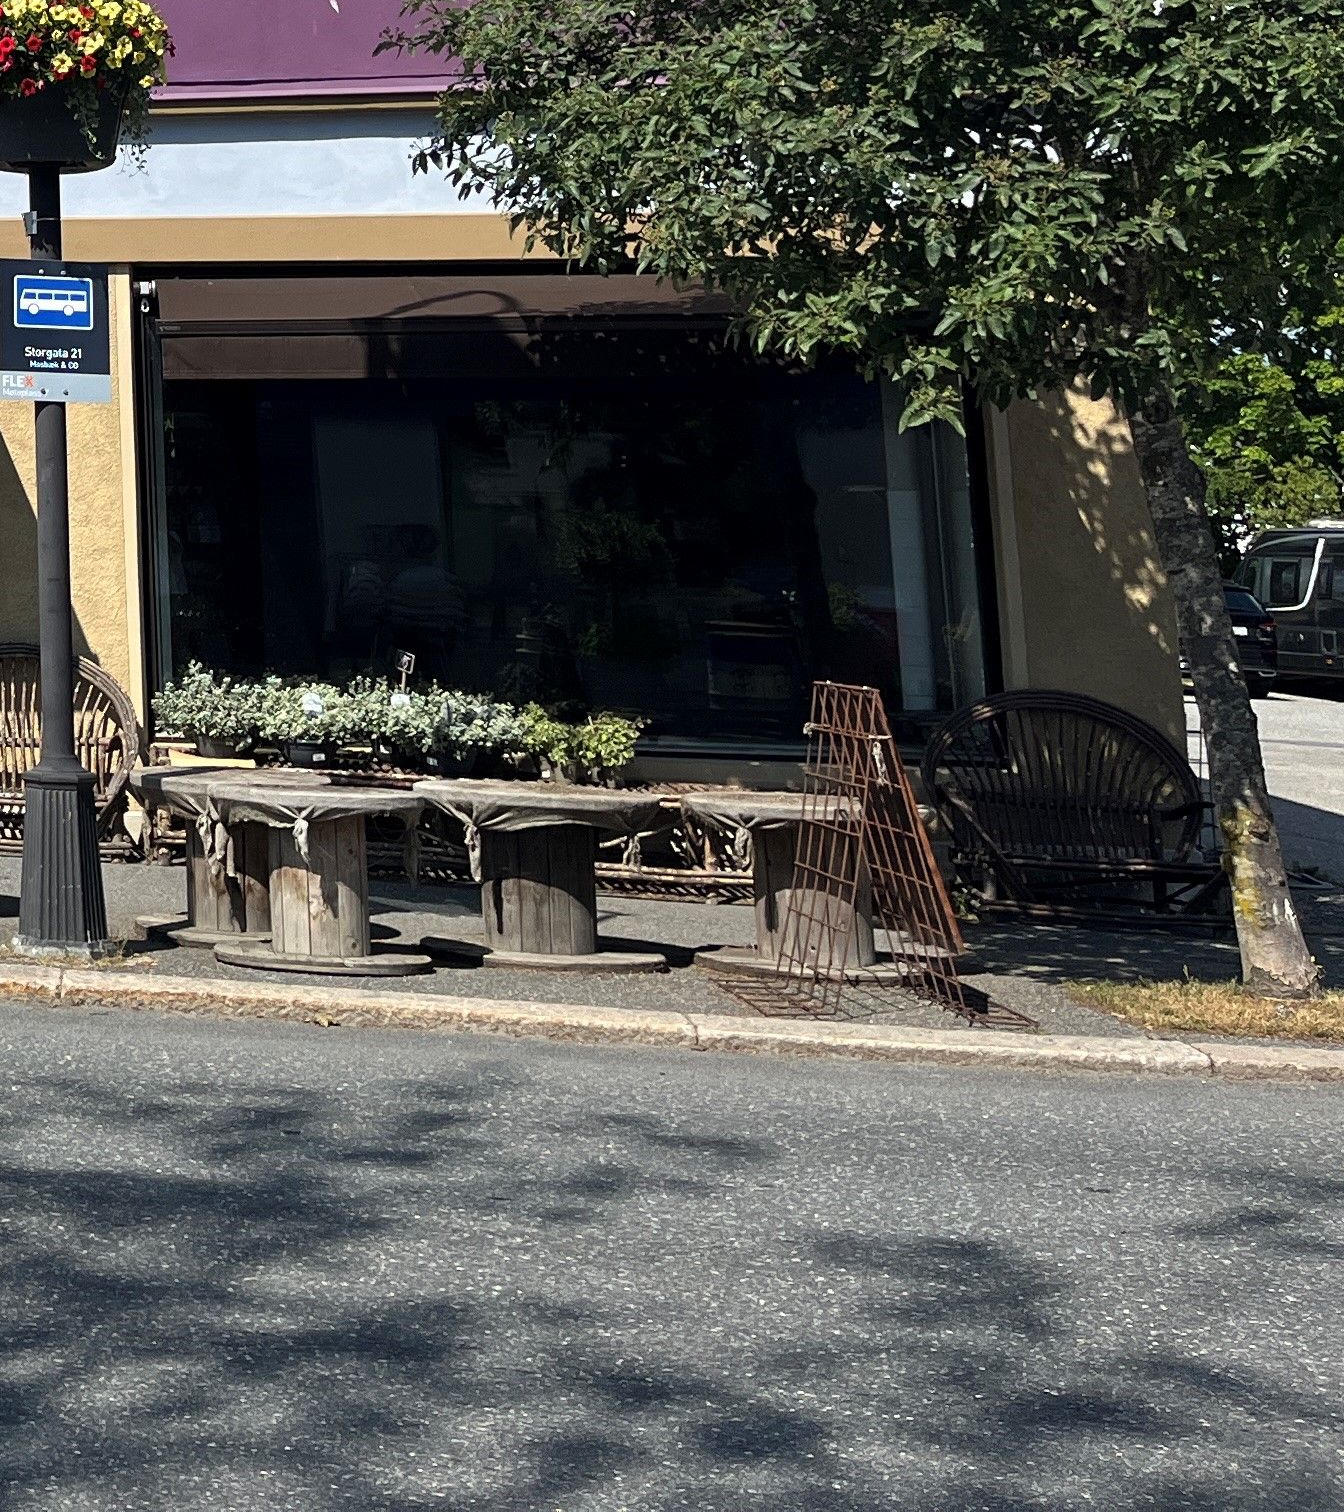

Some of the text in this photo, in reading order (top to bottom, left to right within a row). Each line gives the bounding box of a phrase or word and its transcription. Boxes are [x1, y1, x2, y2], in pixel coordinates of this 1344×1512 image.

[25, 346, 82, 360] Storgata 21
[2, 374, 35, 388] FLEX
